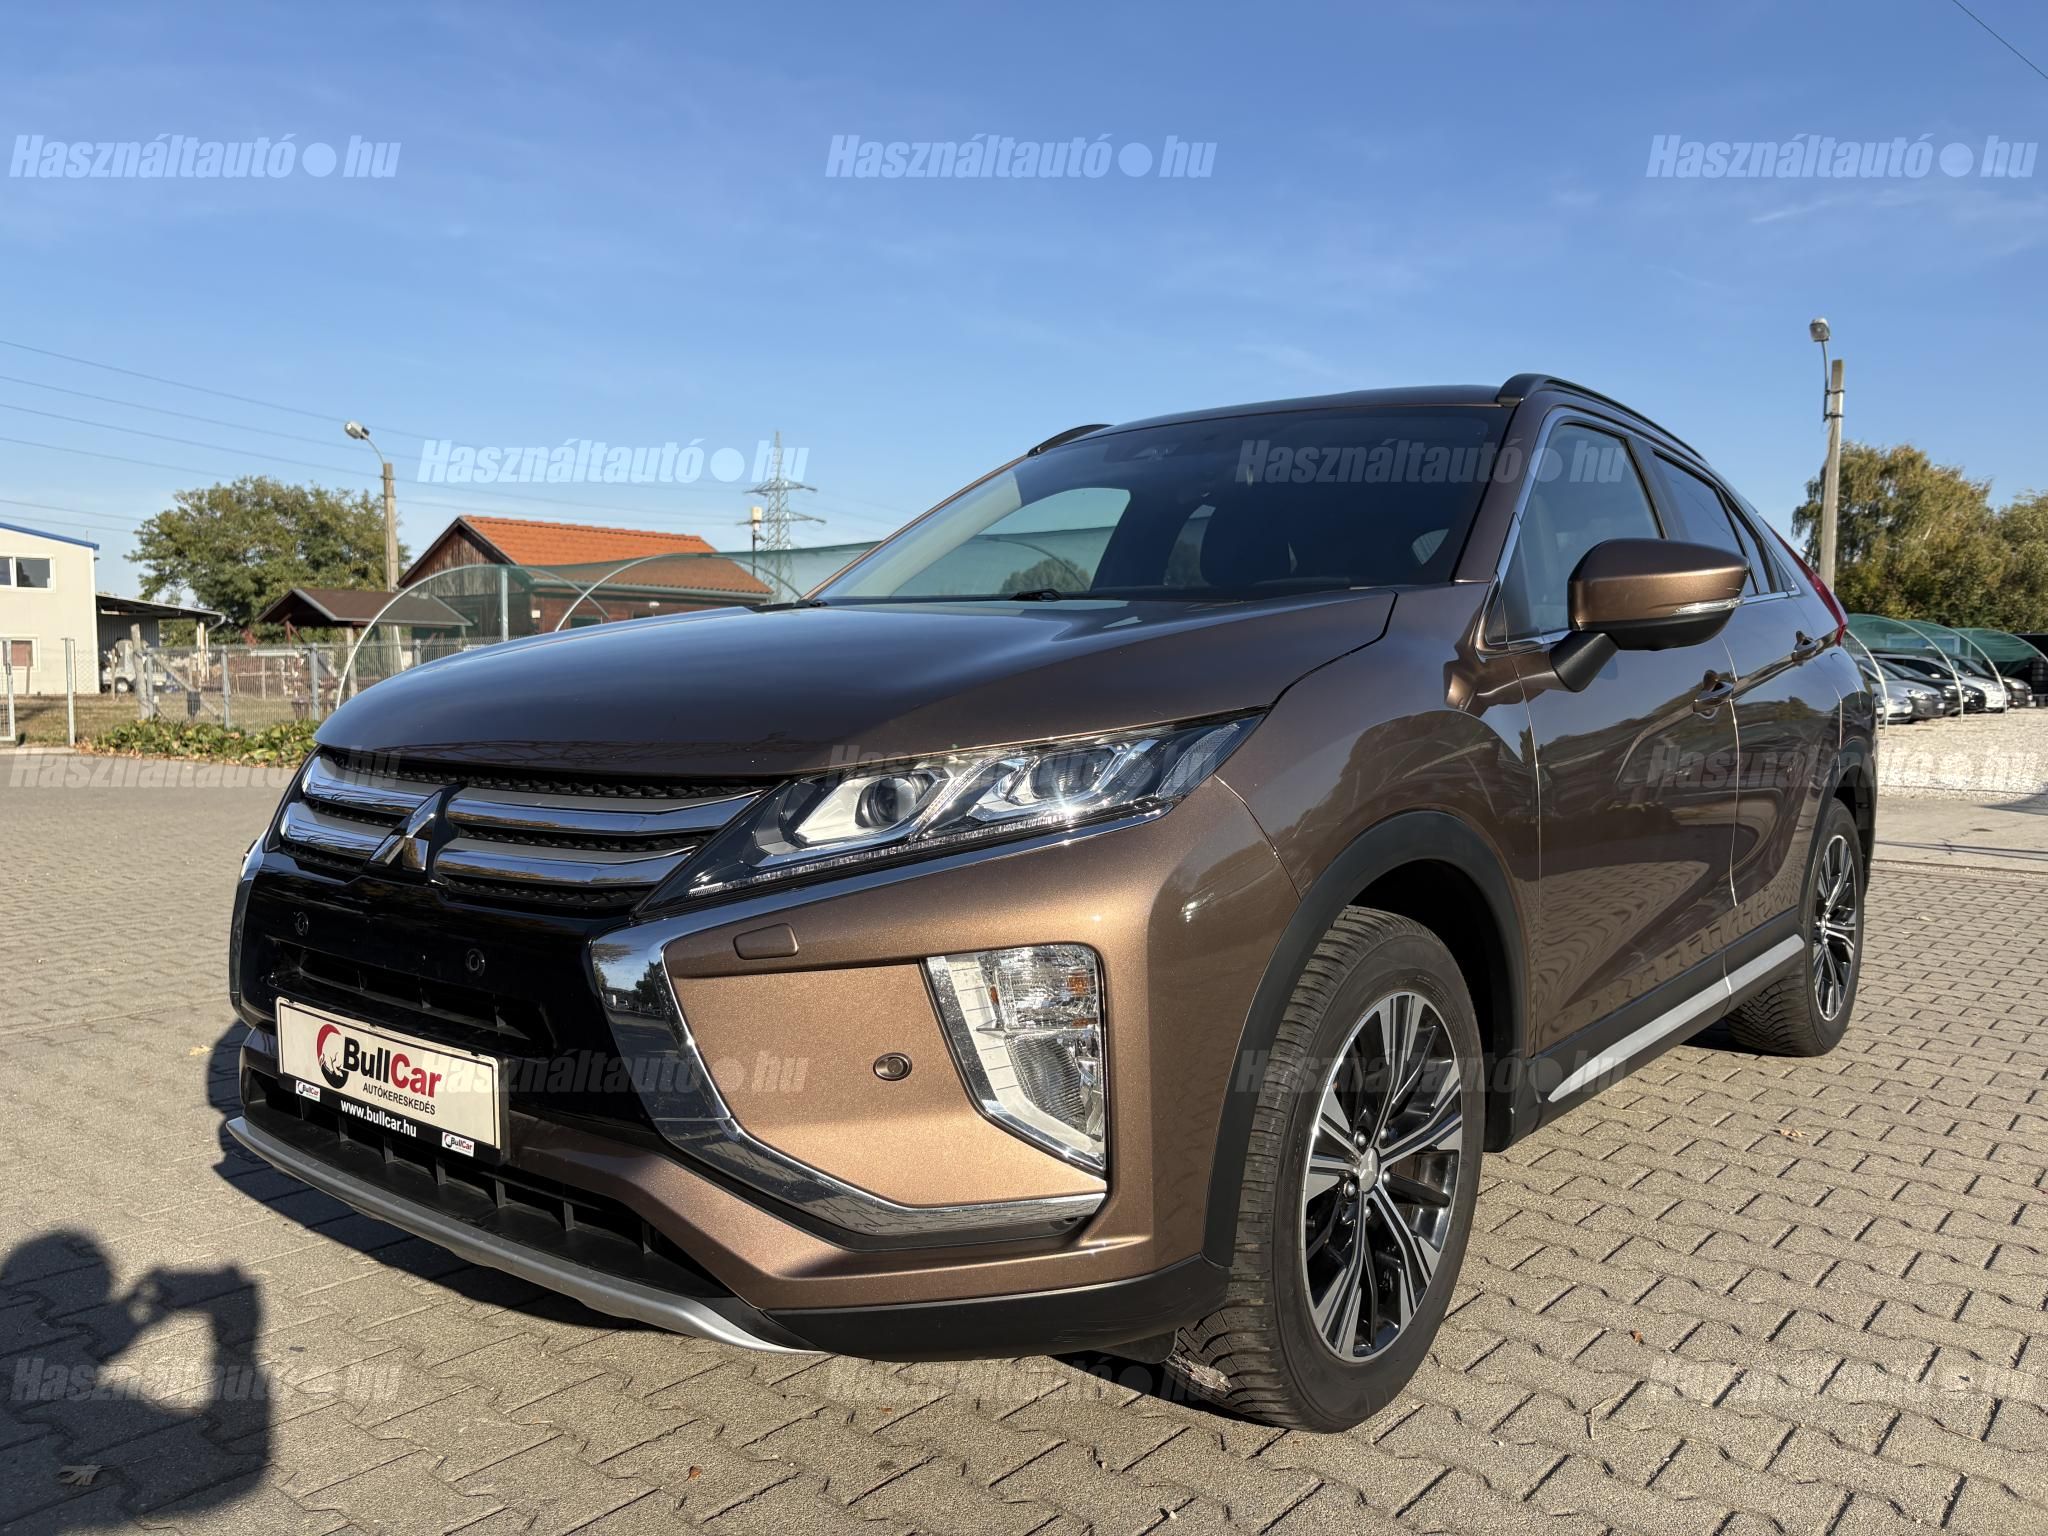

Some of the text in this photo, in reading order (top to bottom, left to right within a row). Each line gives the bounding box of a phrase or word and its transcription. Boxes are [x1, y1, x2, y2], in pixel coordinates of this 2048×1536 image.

[343, 1036, 442, 1098] BullCar
[363, 1082, 436, 1115] AUTÓKERESKEDÉS
[340, 1100, 417, 1137] www.bullcar.hu
